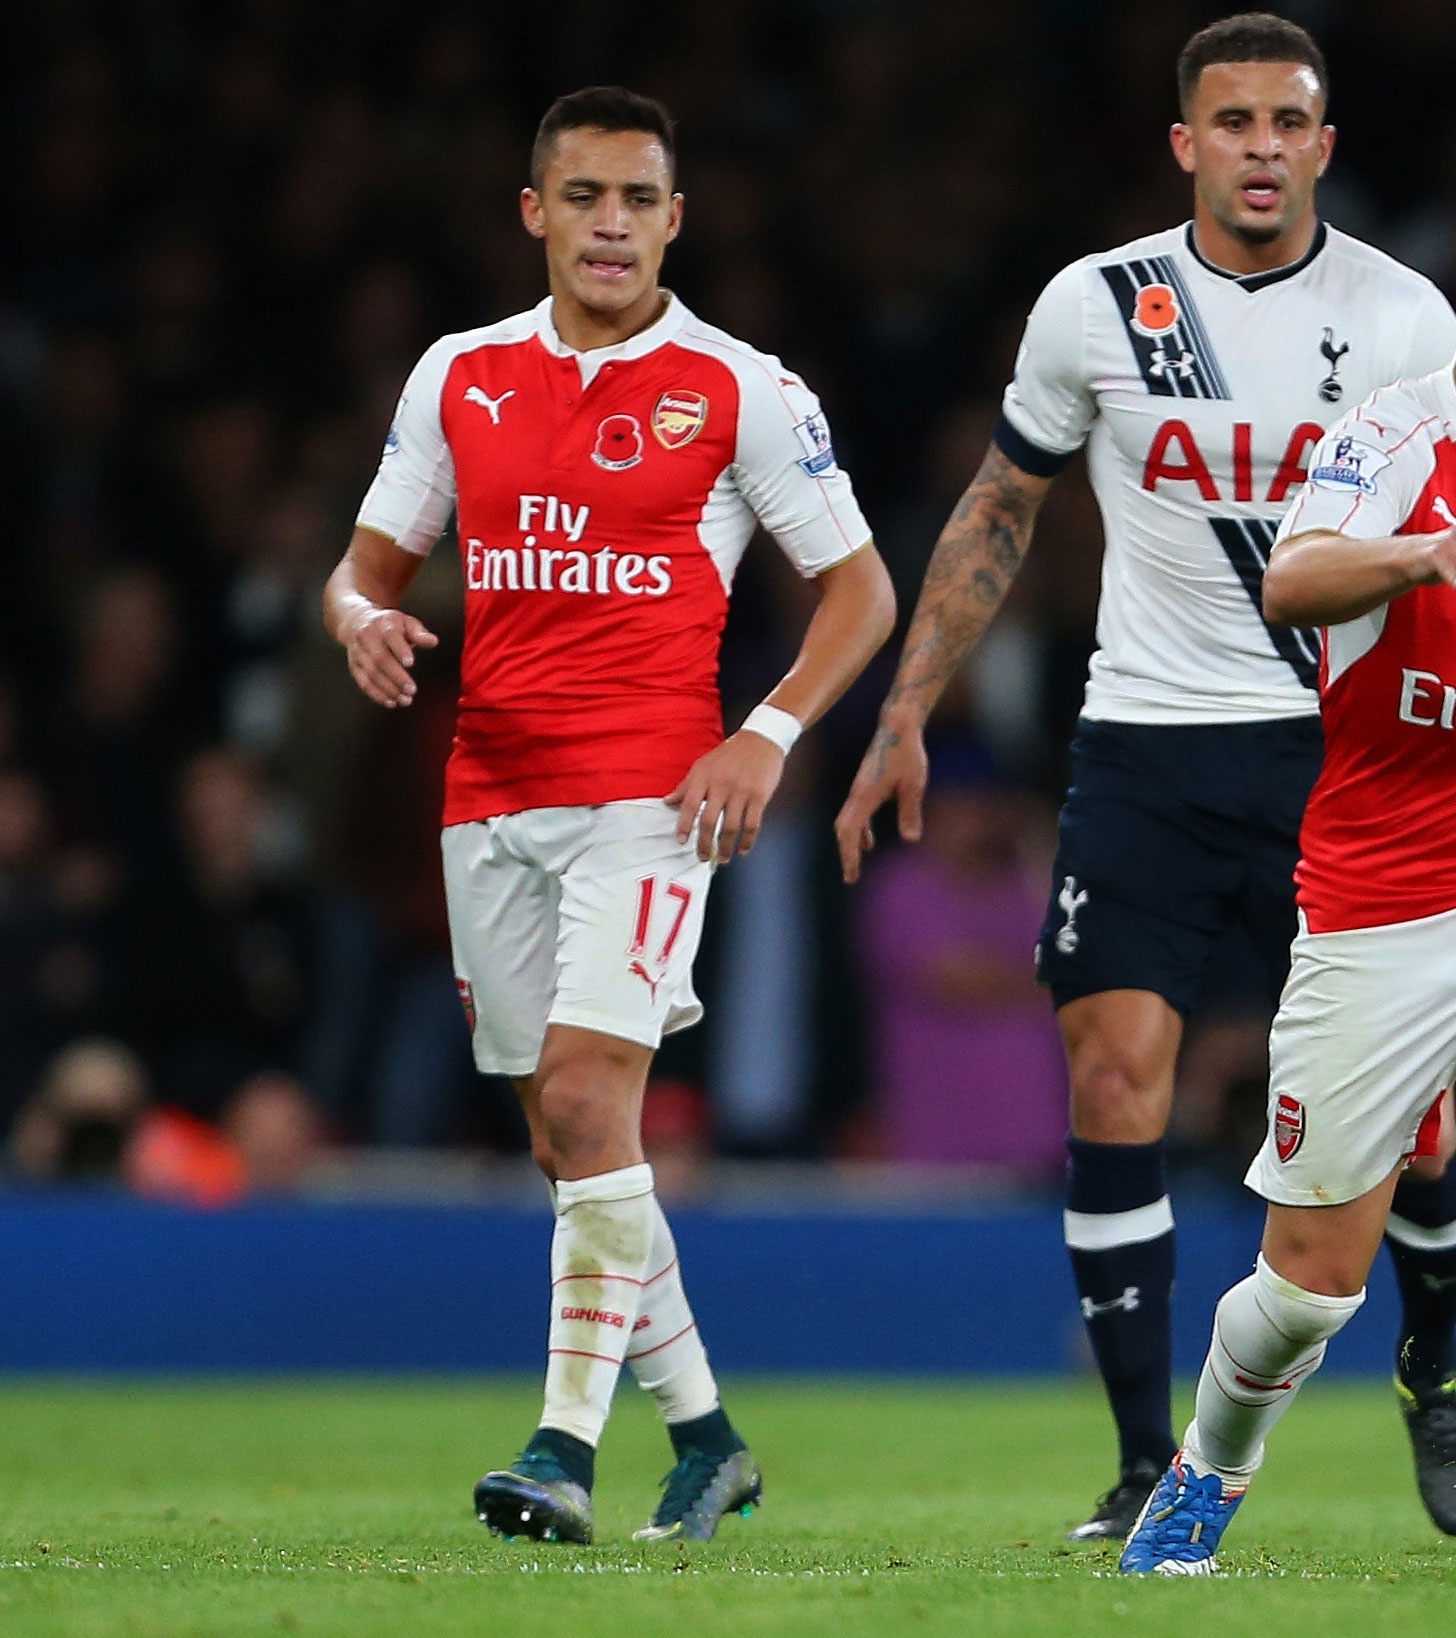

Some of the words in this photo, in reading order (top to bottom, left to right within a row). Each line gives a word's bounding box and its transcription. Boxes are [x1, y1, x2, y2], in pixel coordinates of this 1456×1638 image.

[1142, 418, 1325, 502] AIA
[517, 494, 590, 543] Fly
[465, 535, 672, 597] Emirates
[627, 872, 692, 967] 17
